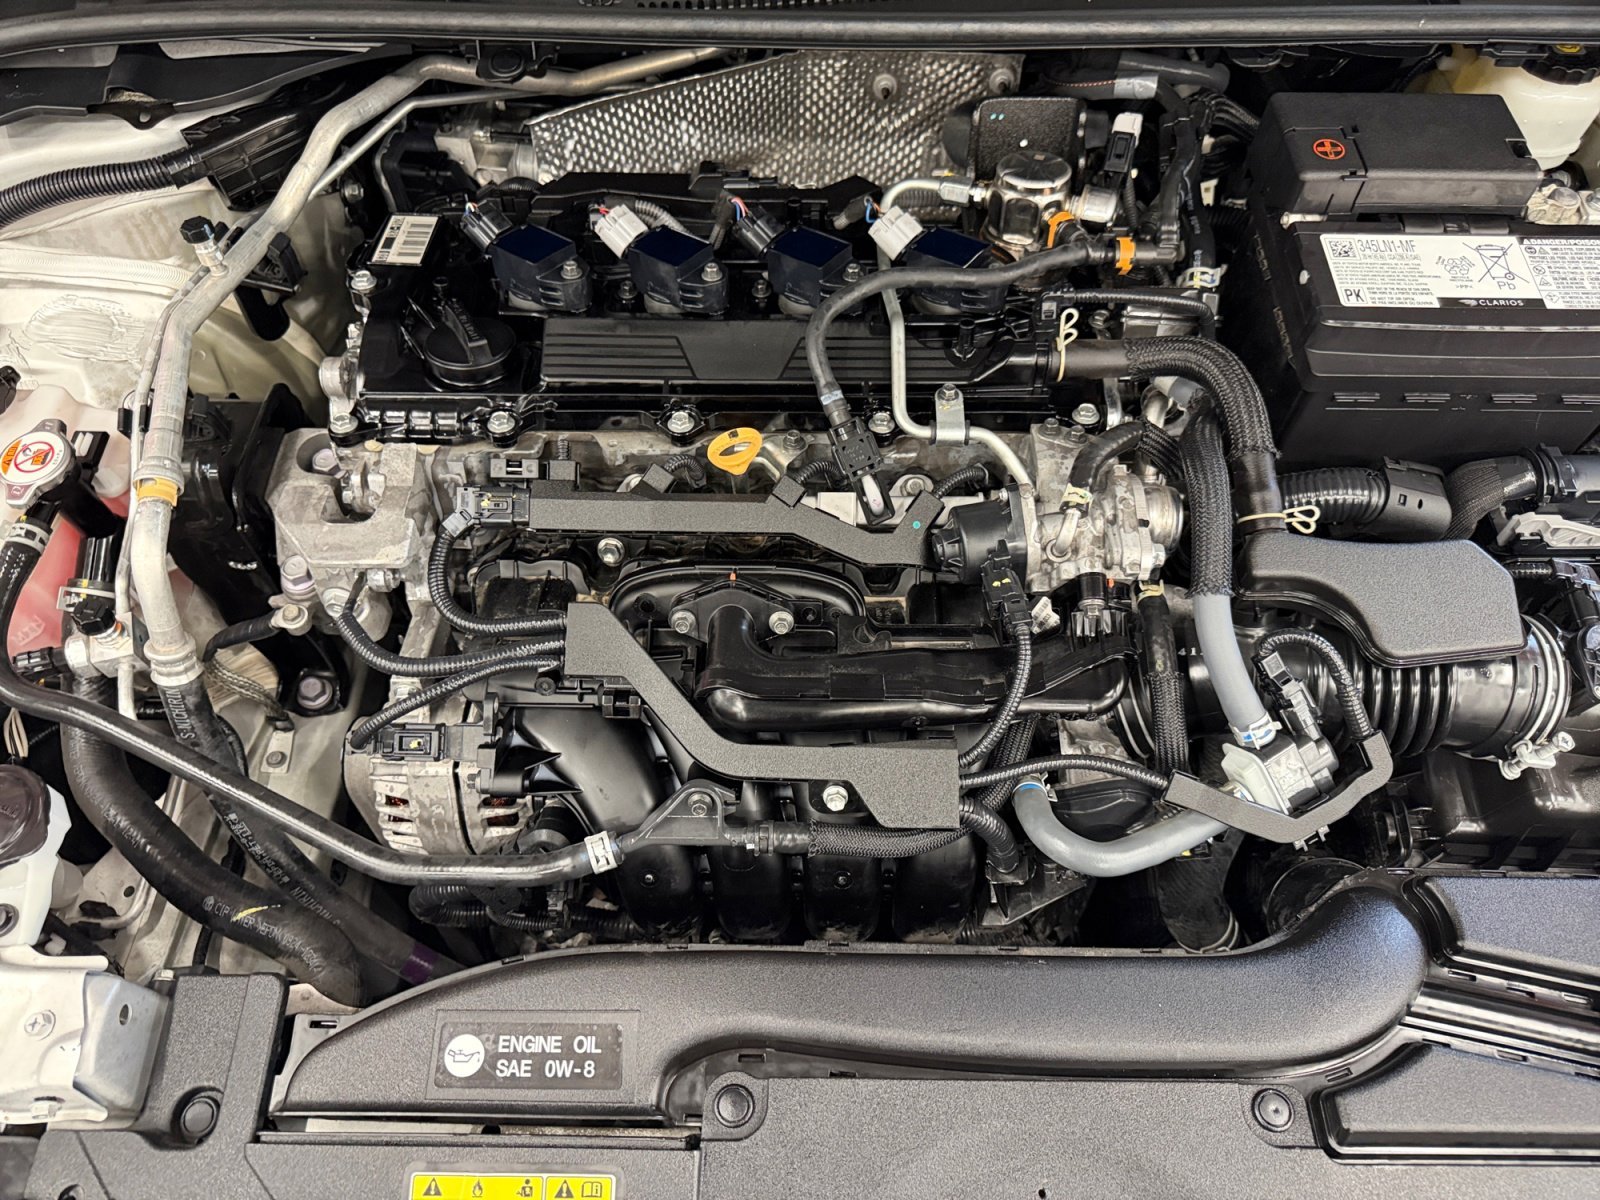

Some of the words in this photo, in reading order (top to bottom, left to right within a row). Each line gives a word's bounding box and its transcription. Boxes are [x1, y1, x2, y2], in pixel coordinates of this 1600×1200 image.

[1357, 240, 1416, 252] 345LN1-MF
[1497, 281, 1516, 290] Pb
[1344, 289, 1365, 302] PK
[498, 1036, 562, 1054] ENGINE
[573, 1036, 602, 1054] OIL
[496, 1060, 532, 1078] SAE
[545, 1060, 596, 1078] 0W-8
